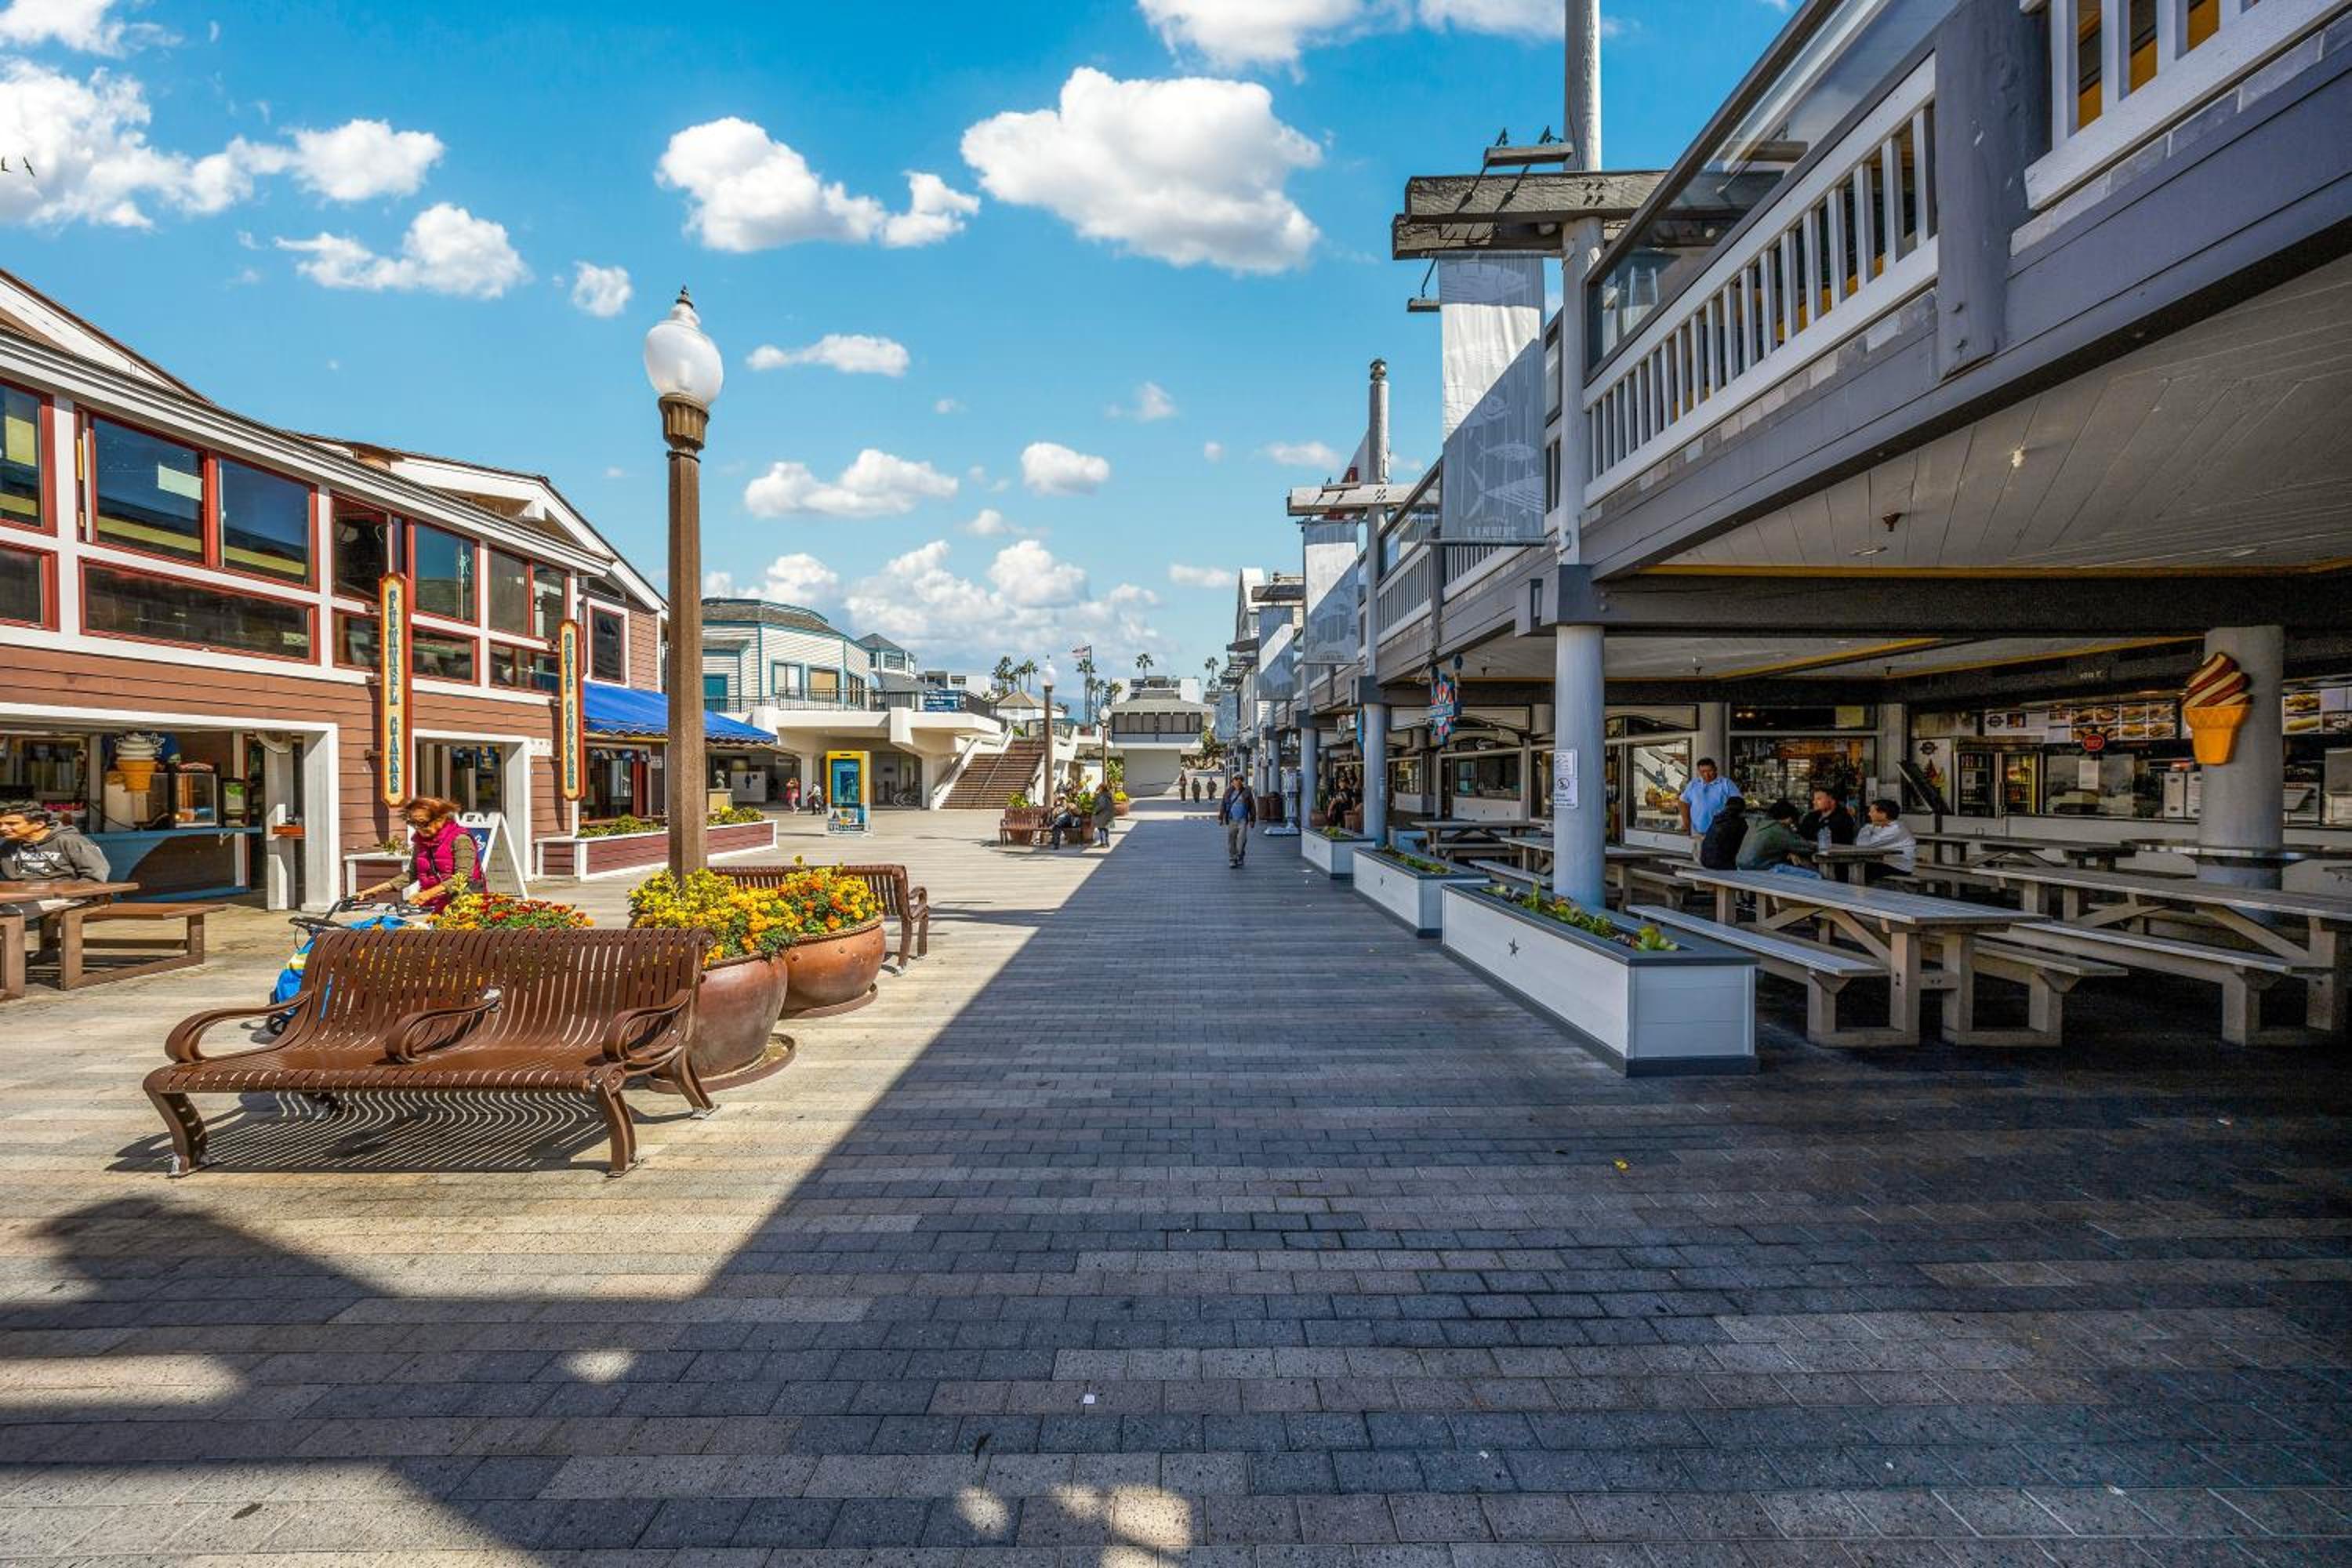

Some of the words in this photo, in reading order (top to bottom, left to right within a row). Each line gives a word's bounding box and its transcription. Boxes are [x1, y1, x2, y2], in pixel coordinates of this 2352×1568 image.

[388, 589, 397, 706] FUNNEL
[564, 633, 573, 694] DRIP
[389, 716, 398, 793] CAKE
[565, 699, 575, 789] COFFEE
